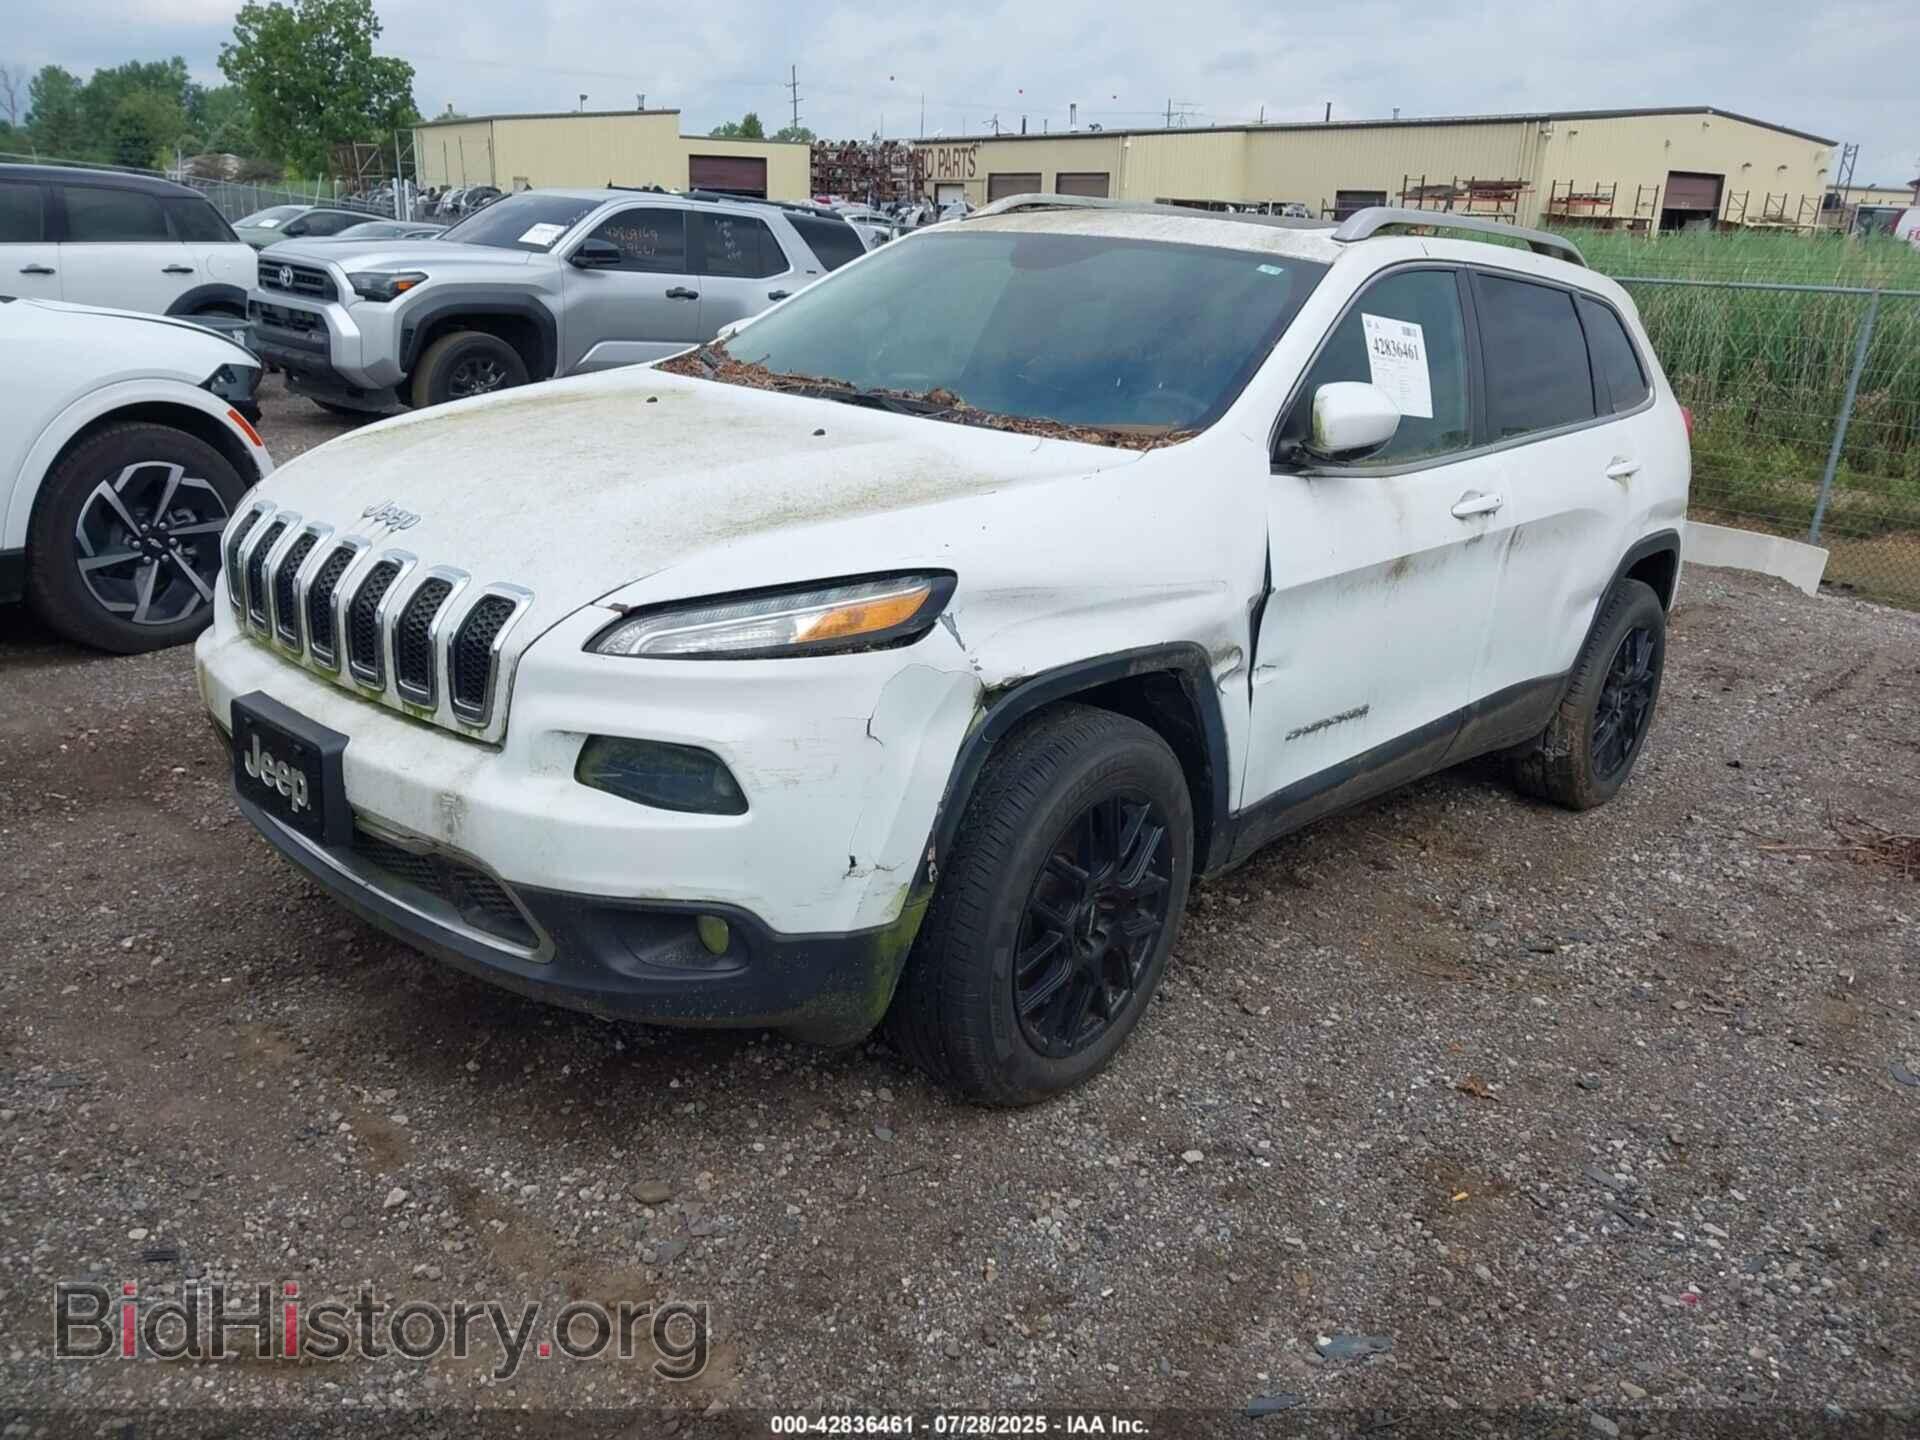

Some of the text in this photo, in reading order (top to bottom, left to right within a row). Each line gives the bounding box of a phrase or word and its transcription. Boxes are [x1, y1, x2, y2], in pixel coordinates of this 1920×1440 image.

[937, 147, 976, 178] PARTS
[1373, 337, 1420, 361] 42836461
[362, 499, 422, 533] Jeep
[244, 733, 309, 814] Jeep
